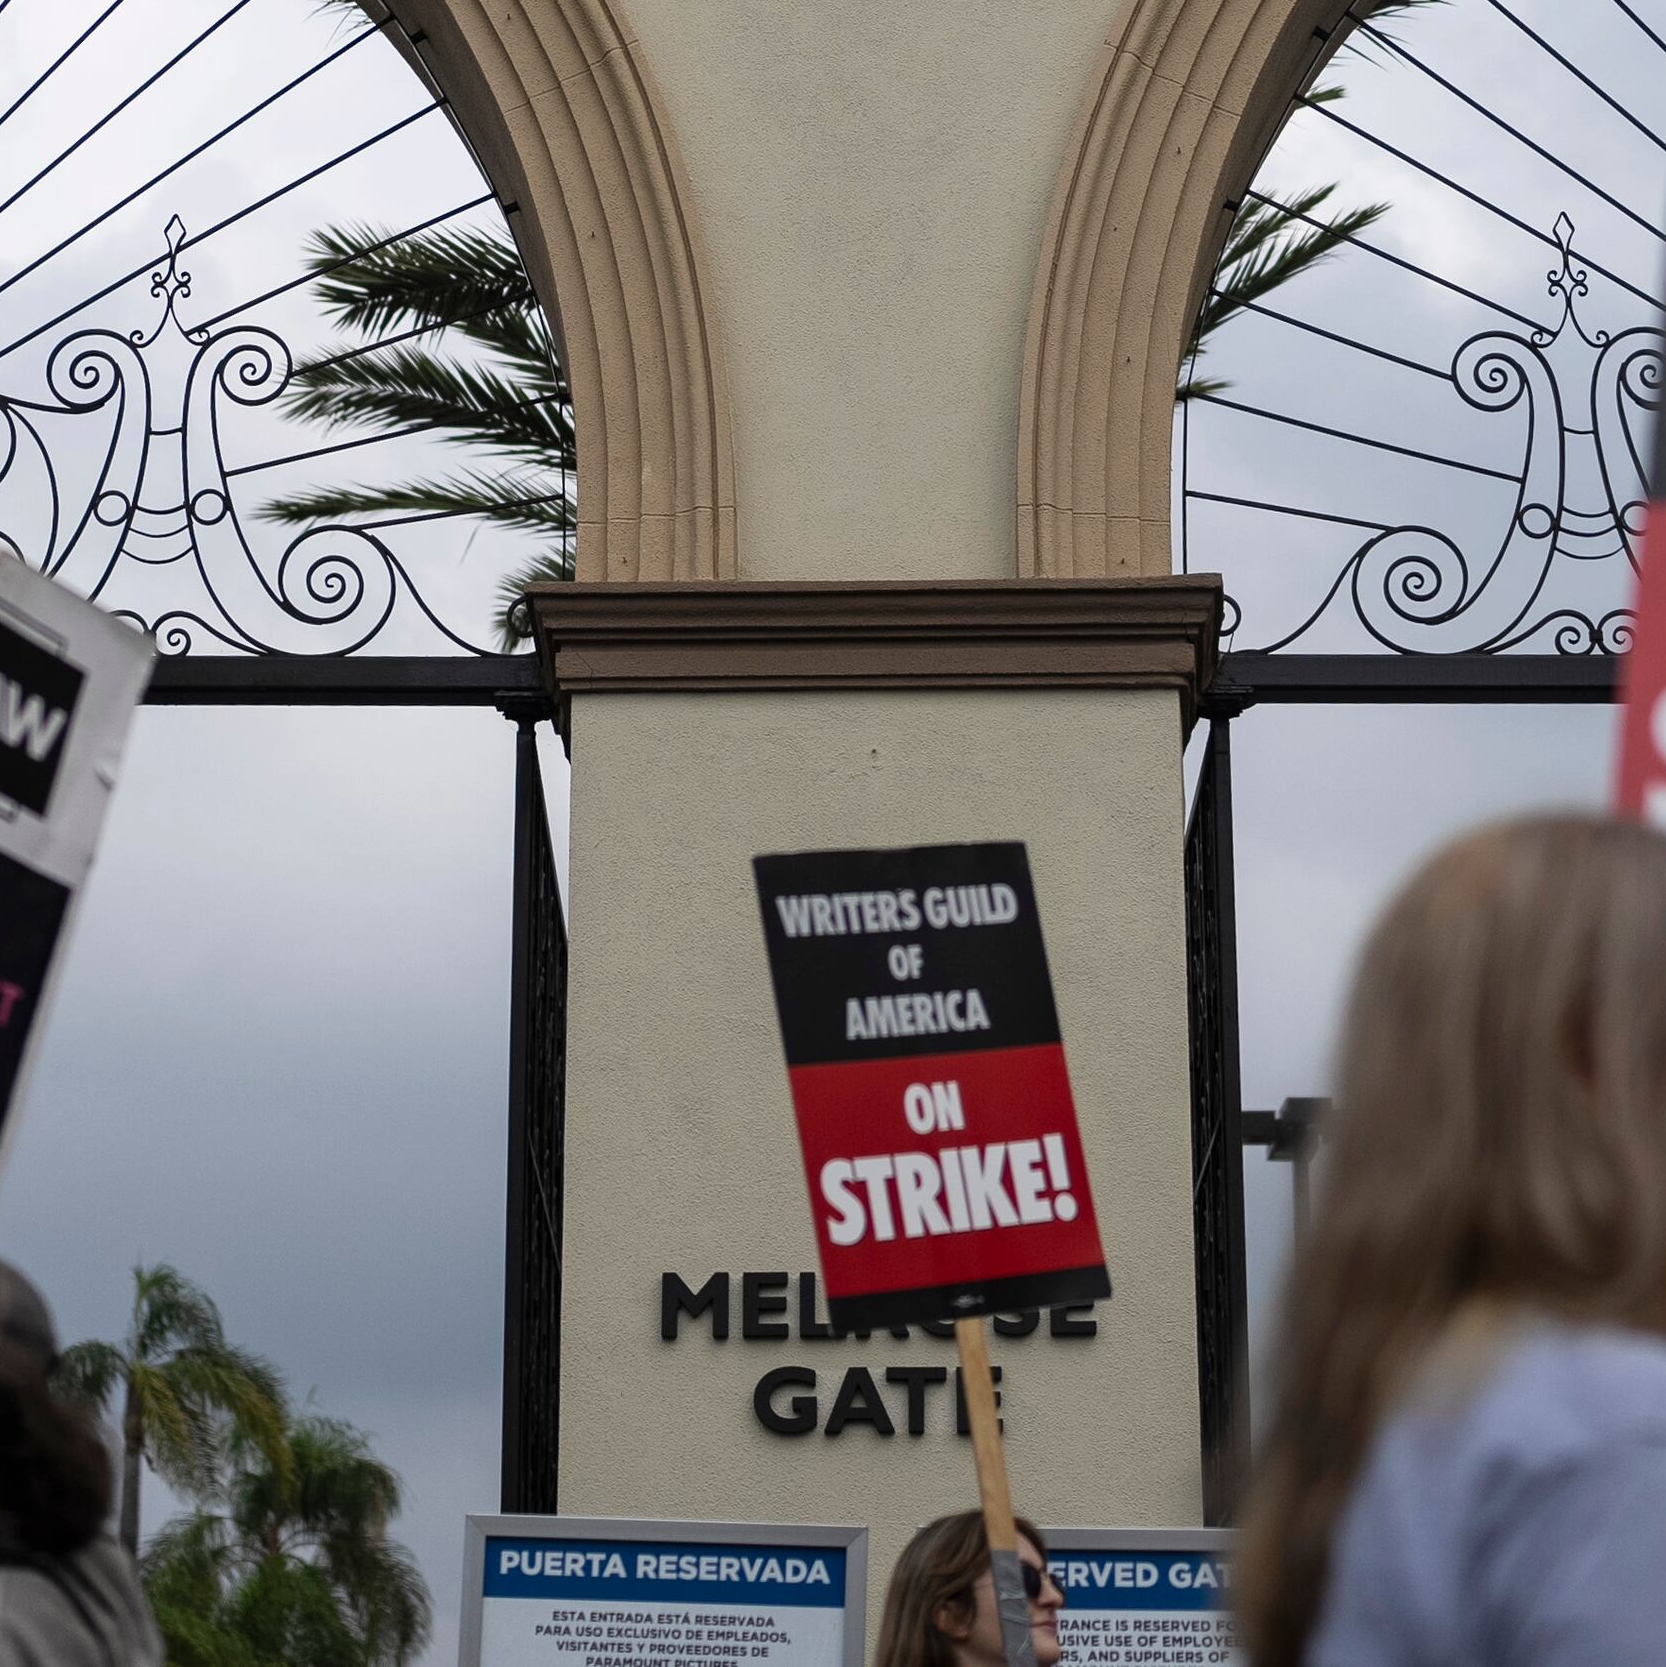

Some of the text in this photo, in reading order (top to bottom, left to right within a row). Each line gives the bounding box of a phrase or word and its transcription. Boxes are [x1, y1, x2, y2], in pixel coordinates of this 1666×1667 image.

[776, 883, 1018, 937] WRITERS GUILD
[888, 944, 923, 981] OF
[846, 988, 990, 1040] AMERICA
[903, 1081, 965, 1134] ON
[820, 1133, 1078, 1246] STRIKE!
[499, 1550, 831, 1585] PUERTA RESERVADA
[535, 1625, 572, 1637] PARA
[576, 1626, 603, 1638] USO
[607, 1628, 681, 1640] EXCLUSIVO
[685, 1630, 703, 1640] DE
[552, 1611, 775, 1628] ESTA ENTRADA ESTÁ RESERVADA
[1115, 1620, 1129, 1632] IS
[1133, 1620, 1211, 1632] RESERVED
[555, 1641, 769, 1657] VISITANTES Y PROVEEDORES DE
[1104, 1635, 1133, 1647] USE
[1137, 1635, 1158, 1647] OF
[1087, 1651, 1120, 1663] AND
[1124, 1651, 1204, 1663] SUPPLIERS
[1208, 1651, 1230, 1663] OF
